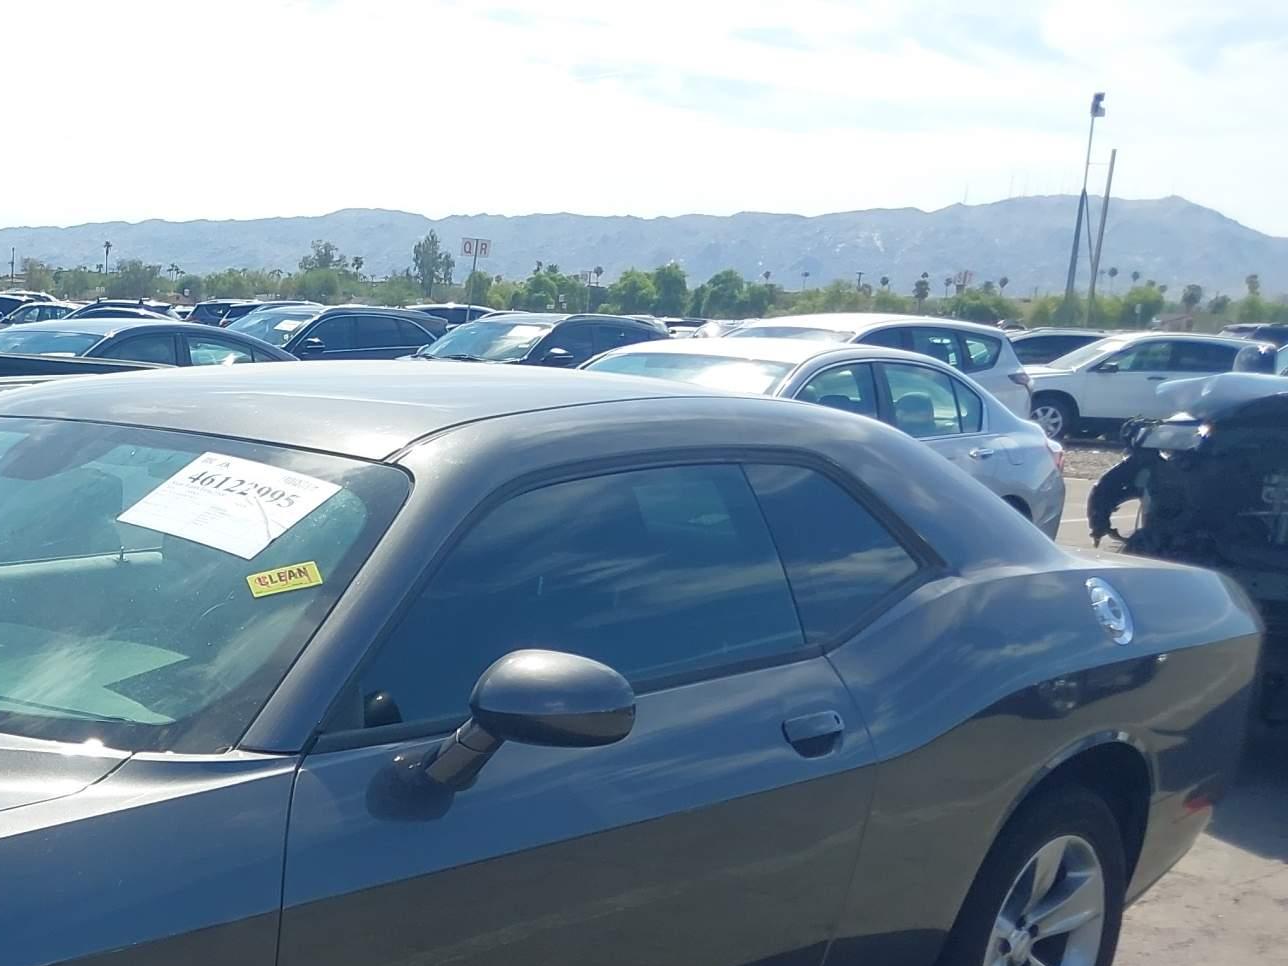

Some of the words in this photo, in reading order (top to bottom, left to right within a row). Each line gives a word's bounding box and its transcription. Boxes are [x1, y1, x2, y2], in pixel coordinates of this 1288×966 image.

[464, 241, 472, 254] Q
[480, 243, 488, 255] R
[257, 567, 308, 586] CLEAN
